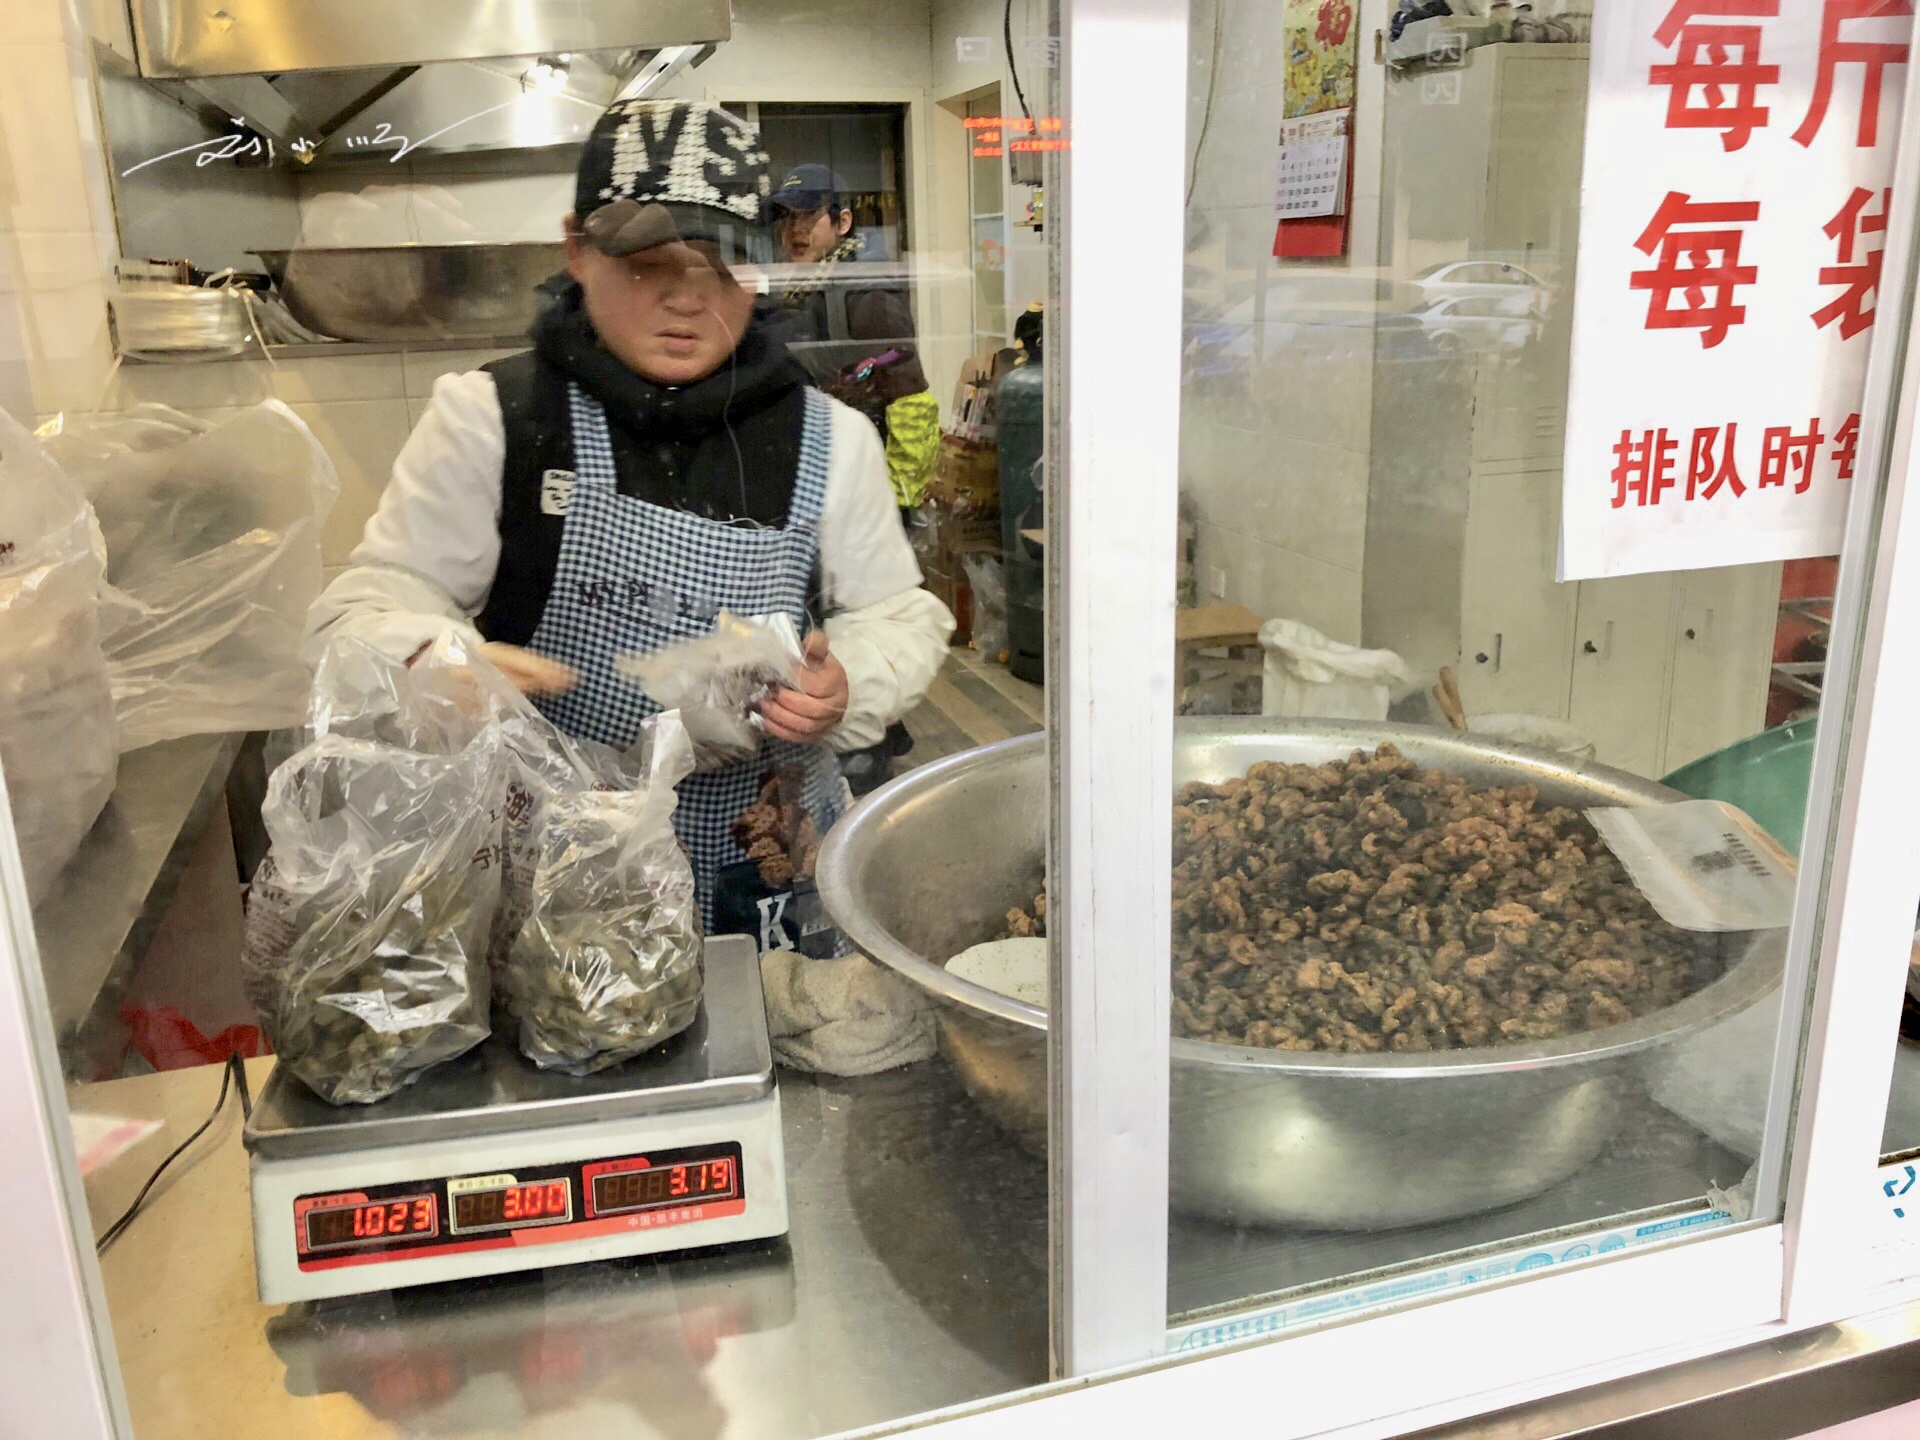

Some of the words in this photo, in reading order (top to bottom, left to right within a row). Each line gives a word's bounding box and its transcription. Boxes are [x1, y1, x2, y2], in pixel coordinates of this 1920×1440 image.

[1648, 0, 1914, 152] 每斤
[353, 1199, 431, 1237] 1.023
[503, 1181, 566, 1219] 3.00
